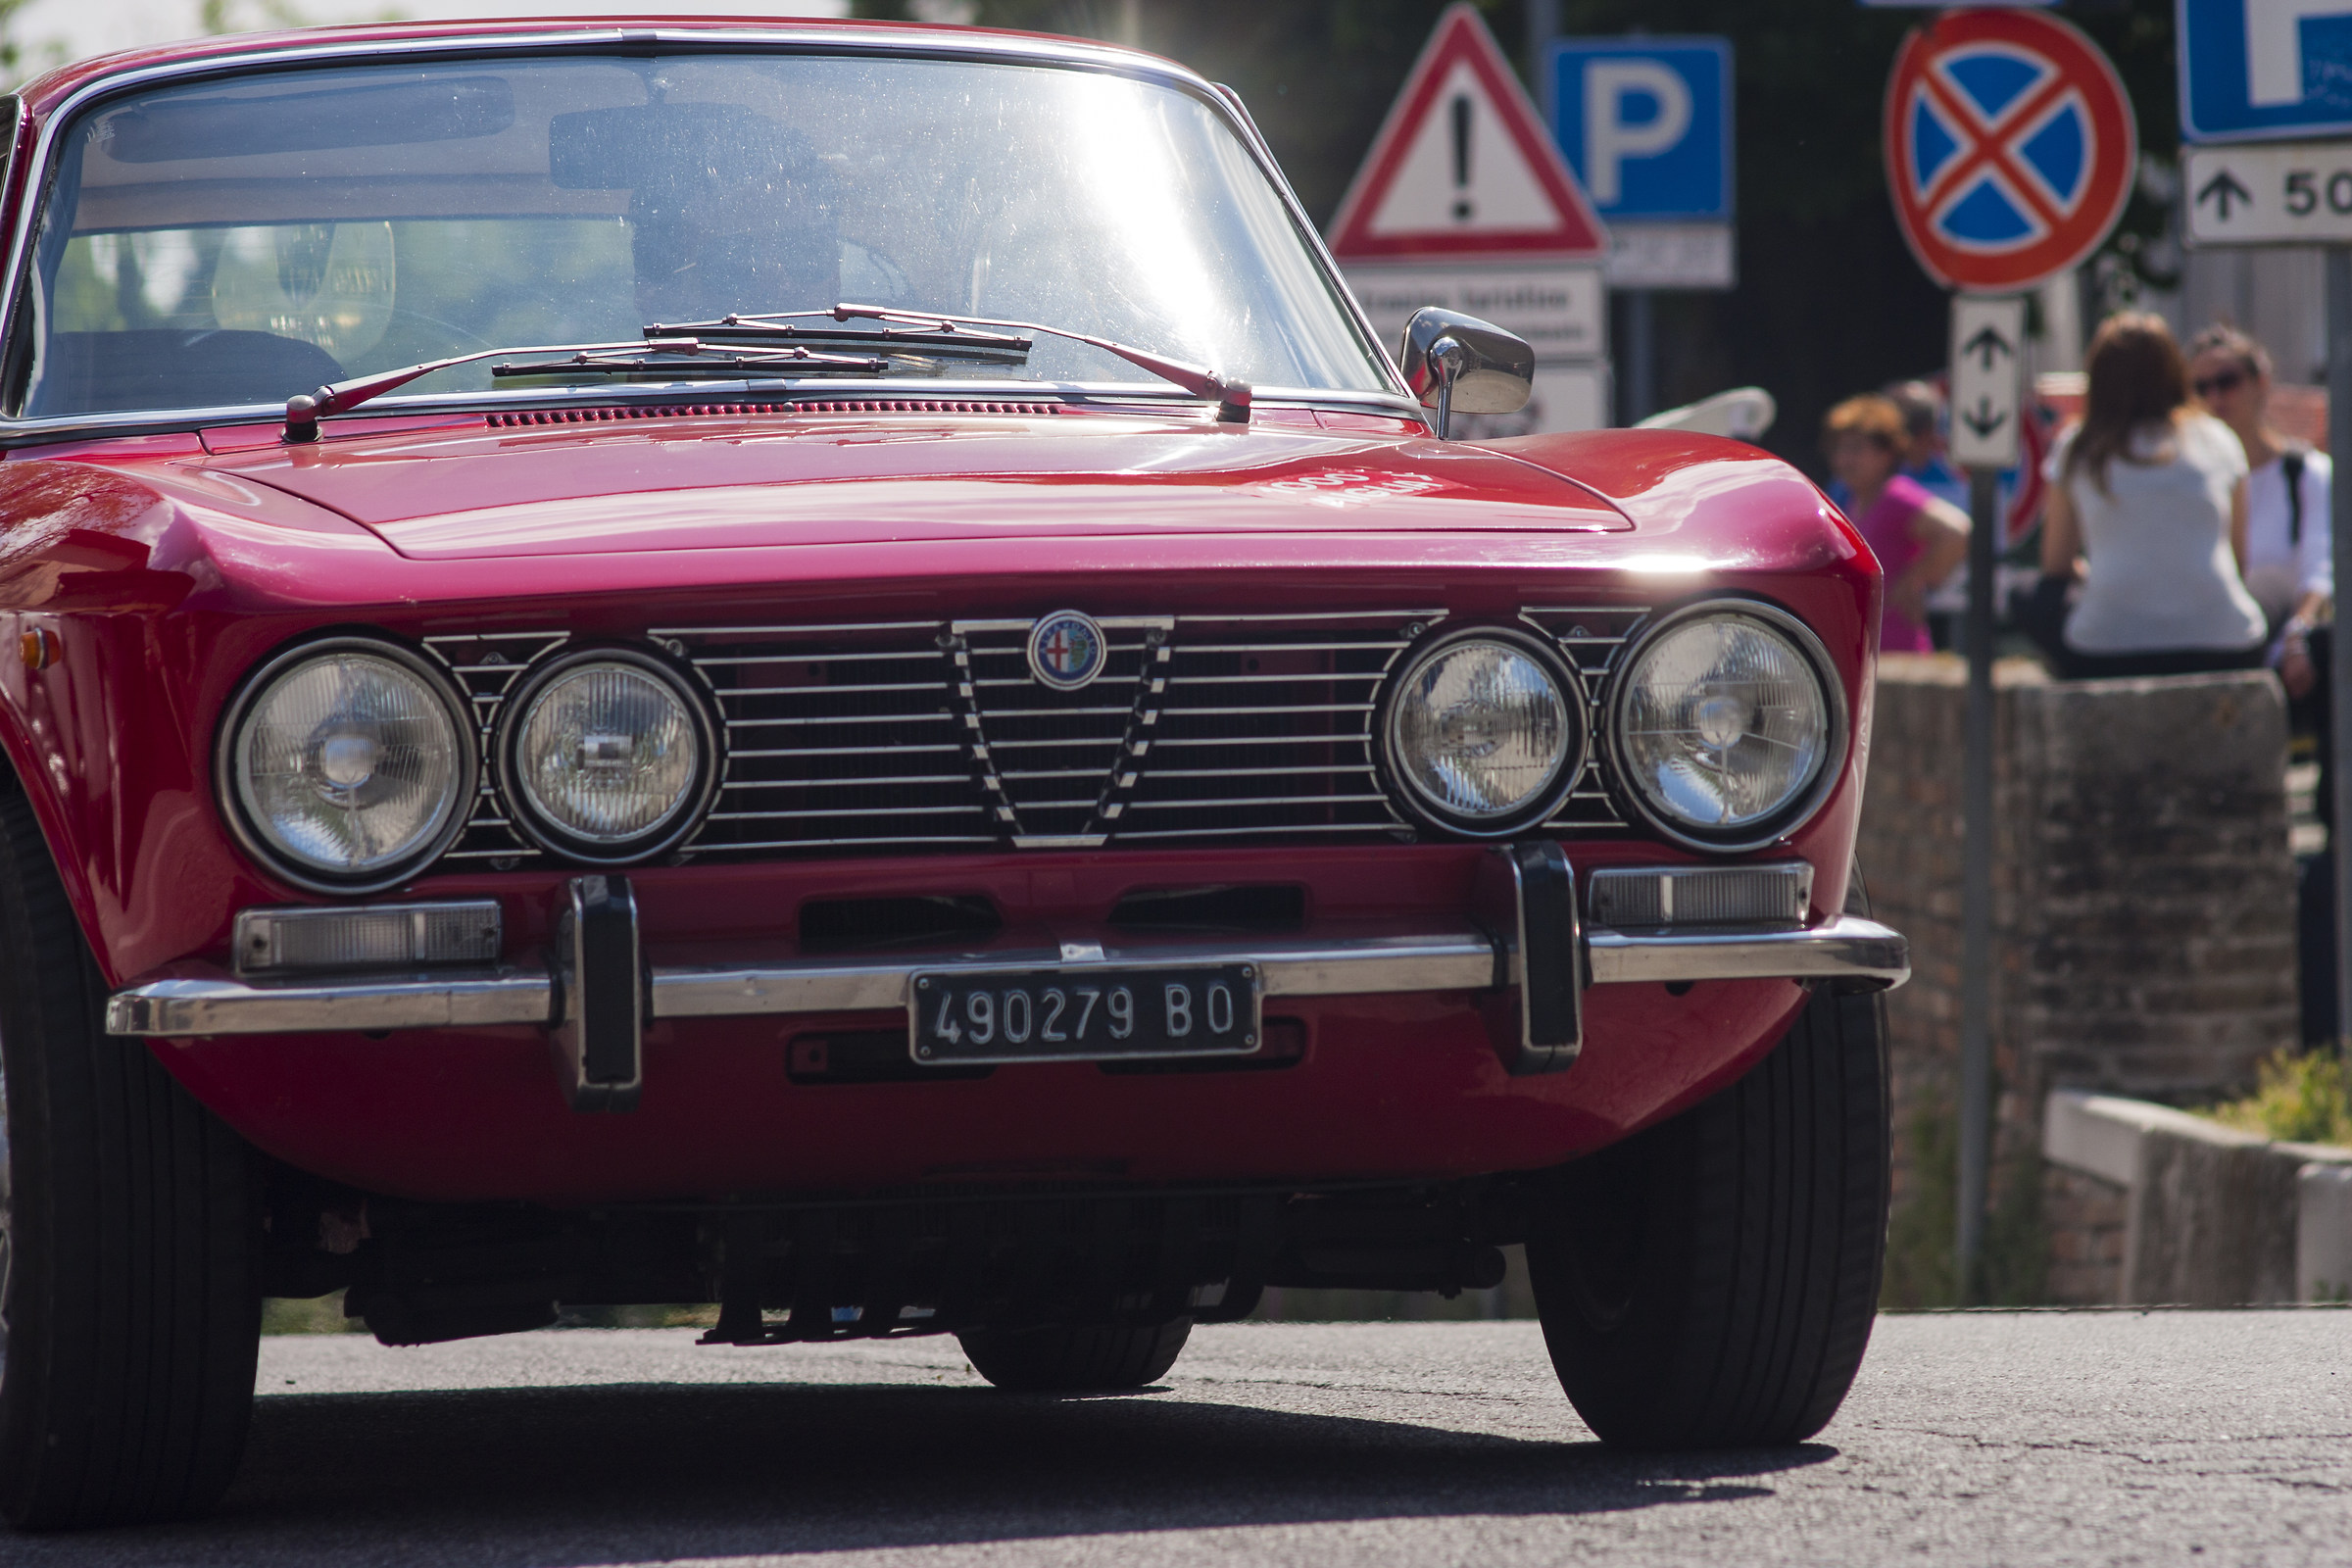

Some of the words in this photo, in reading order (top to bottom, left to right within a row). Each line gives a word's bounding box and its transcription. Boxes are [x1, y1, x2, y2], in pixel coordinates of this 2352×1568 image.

[1584, 60, 1693, 206] P
[1257, 472, 1370, 495] 1000
[935, 985, 1134, 1044] 490279
